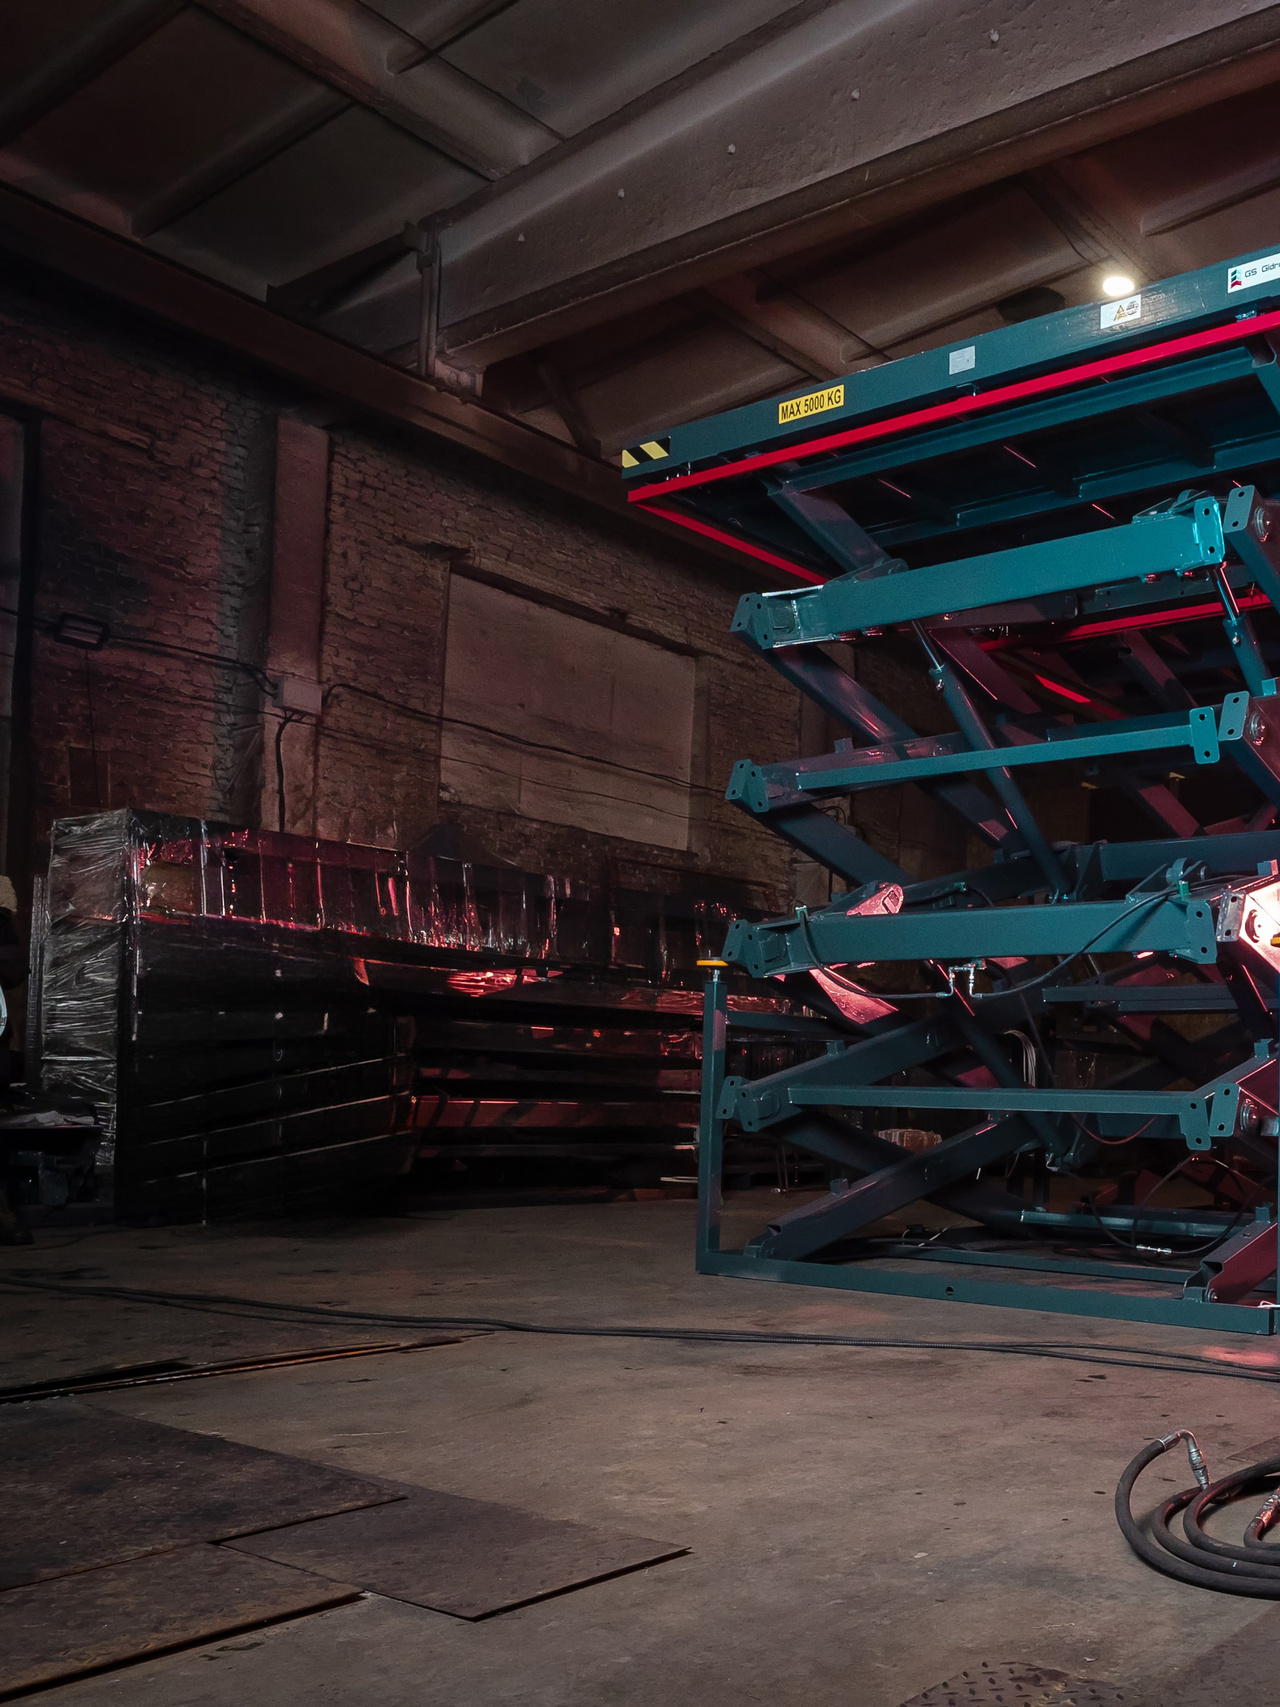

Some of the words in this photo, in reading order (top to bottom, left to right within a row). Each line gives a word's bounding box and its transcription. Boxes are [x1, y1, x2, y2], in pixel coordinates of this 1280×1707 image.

[1244, 267, 1257, 278] GS
[781, 400, 802, 420] MAX
[804, 393, 825, 414] 5000
[827, 389, 841, 407] KG
